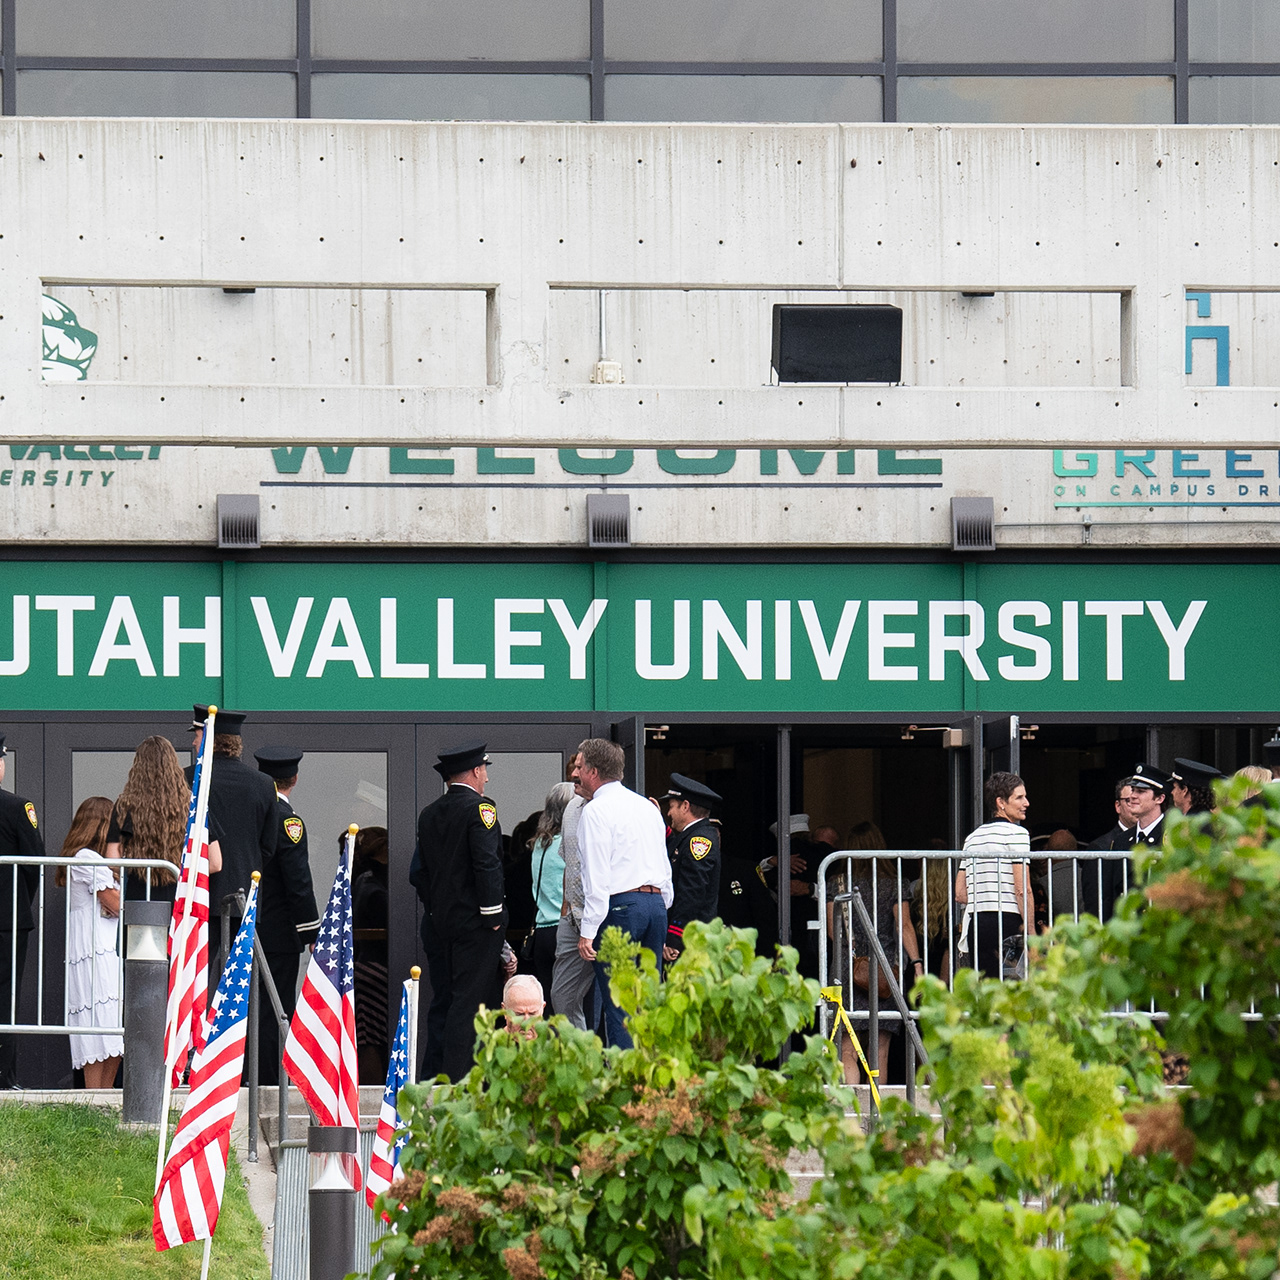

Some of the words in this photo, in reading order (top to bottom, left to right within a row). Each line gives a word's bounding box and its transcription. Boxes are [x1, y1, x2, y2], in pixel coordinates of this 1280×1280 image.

[1054, 484, 1087, 497] ON
[1110, 484, 1216, 497] CAMPUS
[250, 597, 609, 680] VALLEY
[635, 599, 1208, 682] UNIVERSITY
